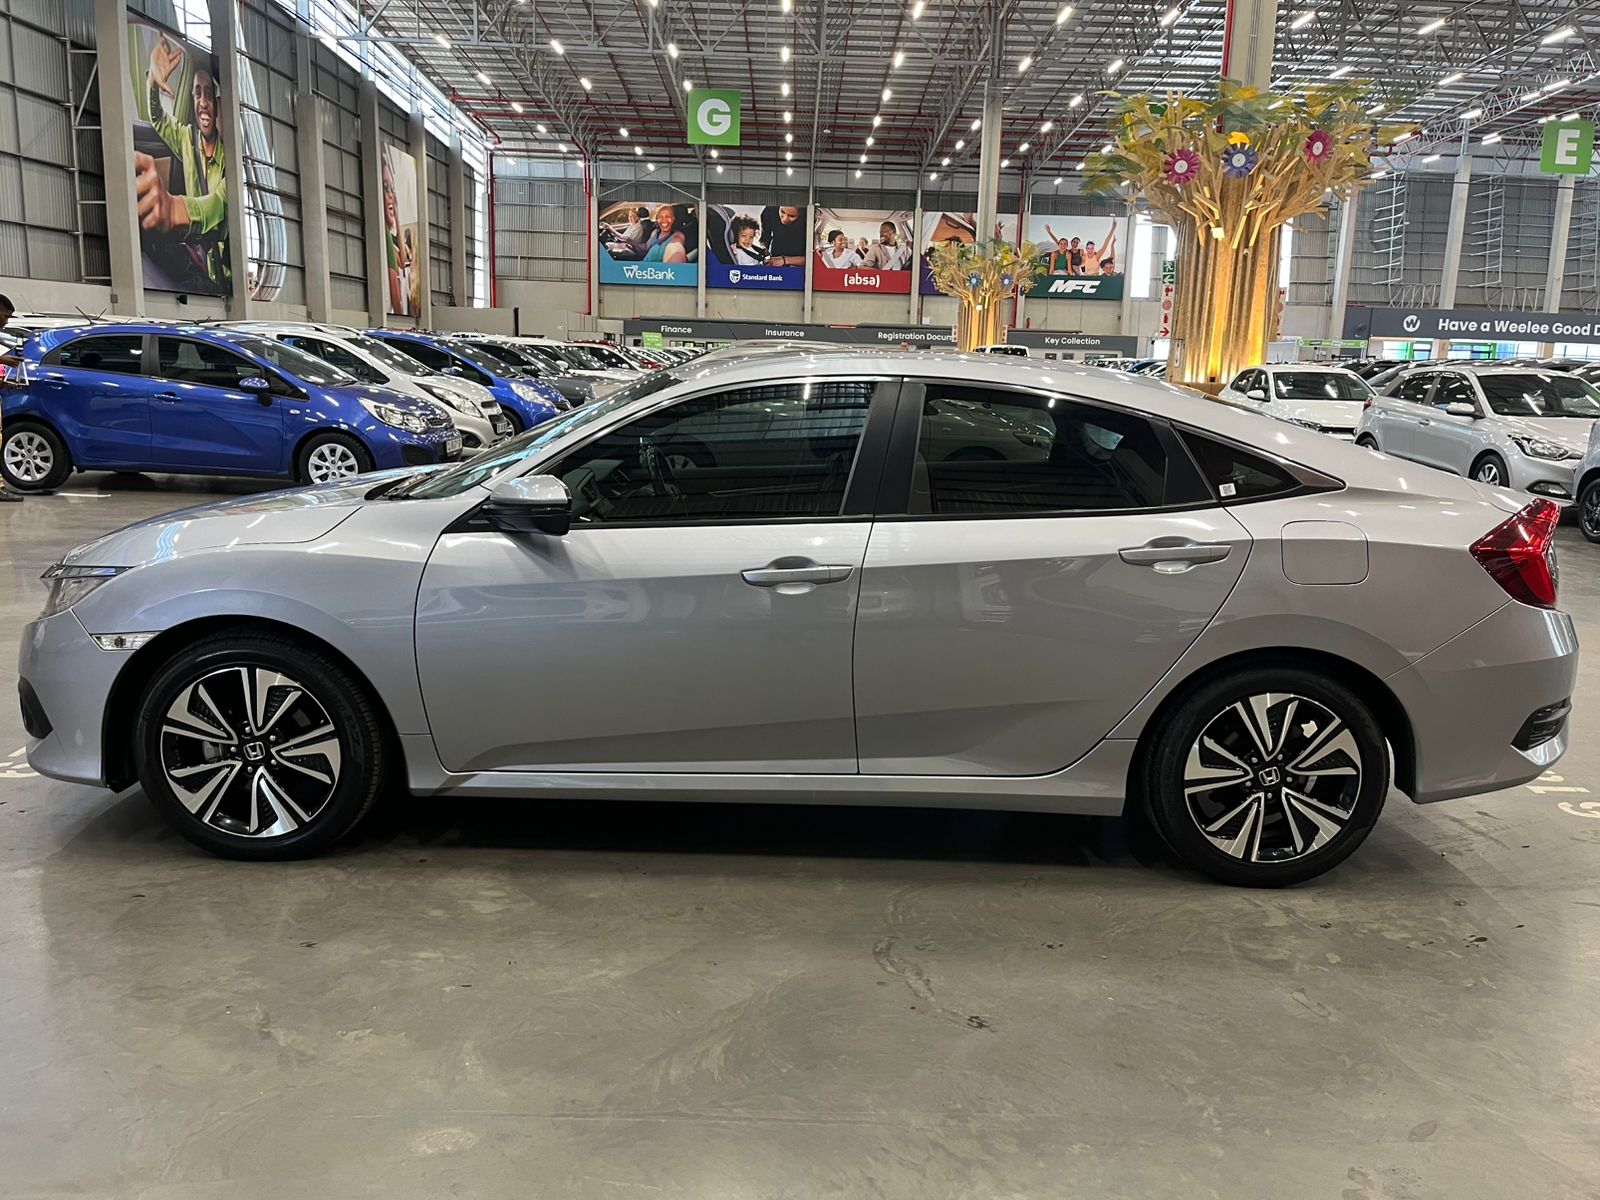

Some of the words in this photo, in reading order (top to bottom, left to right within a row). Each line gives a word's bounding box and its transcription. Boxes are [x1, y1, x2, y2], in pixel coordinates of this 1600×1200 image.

[697, 99, 731, 136] G
[1555, 129, 1580, 165] E
[623, 264, 676, 281] WesBank
[742, 273, 768, 282] Standard
[768, 274, 783, 282] Bank
[843, 273, 881, 288] (absa)
[1047, 279, 1102, 294] MFC
[660, 325, 693, 334] Finance
[765, 328, 805, 338] Insurance
[1438, 318, 1478, 332] Have
[1480, 321, 1491, 332] a
[1494, 320, 1549, 334] Weelee
[1551, 322, 1591, 336] Good
[877, 331, 925, 343] Registration
[1044, 336, 1060, 346] Key
[1061, 337, 1101, 346] Collection
